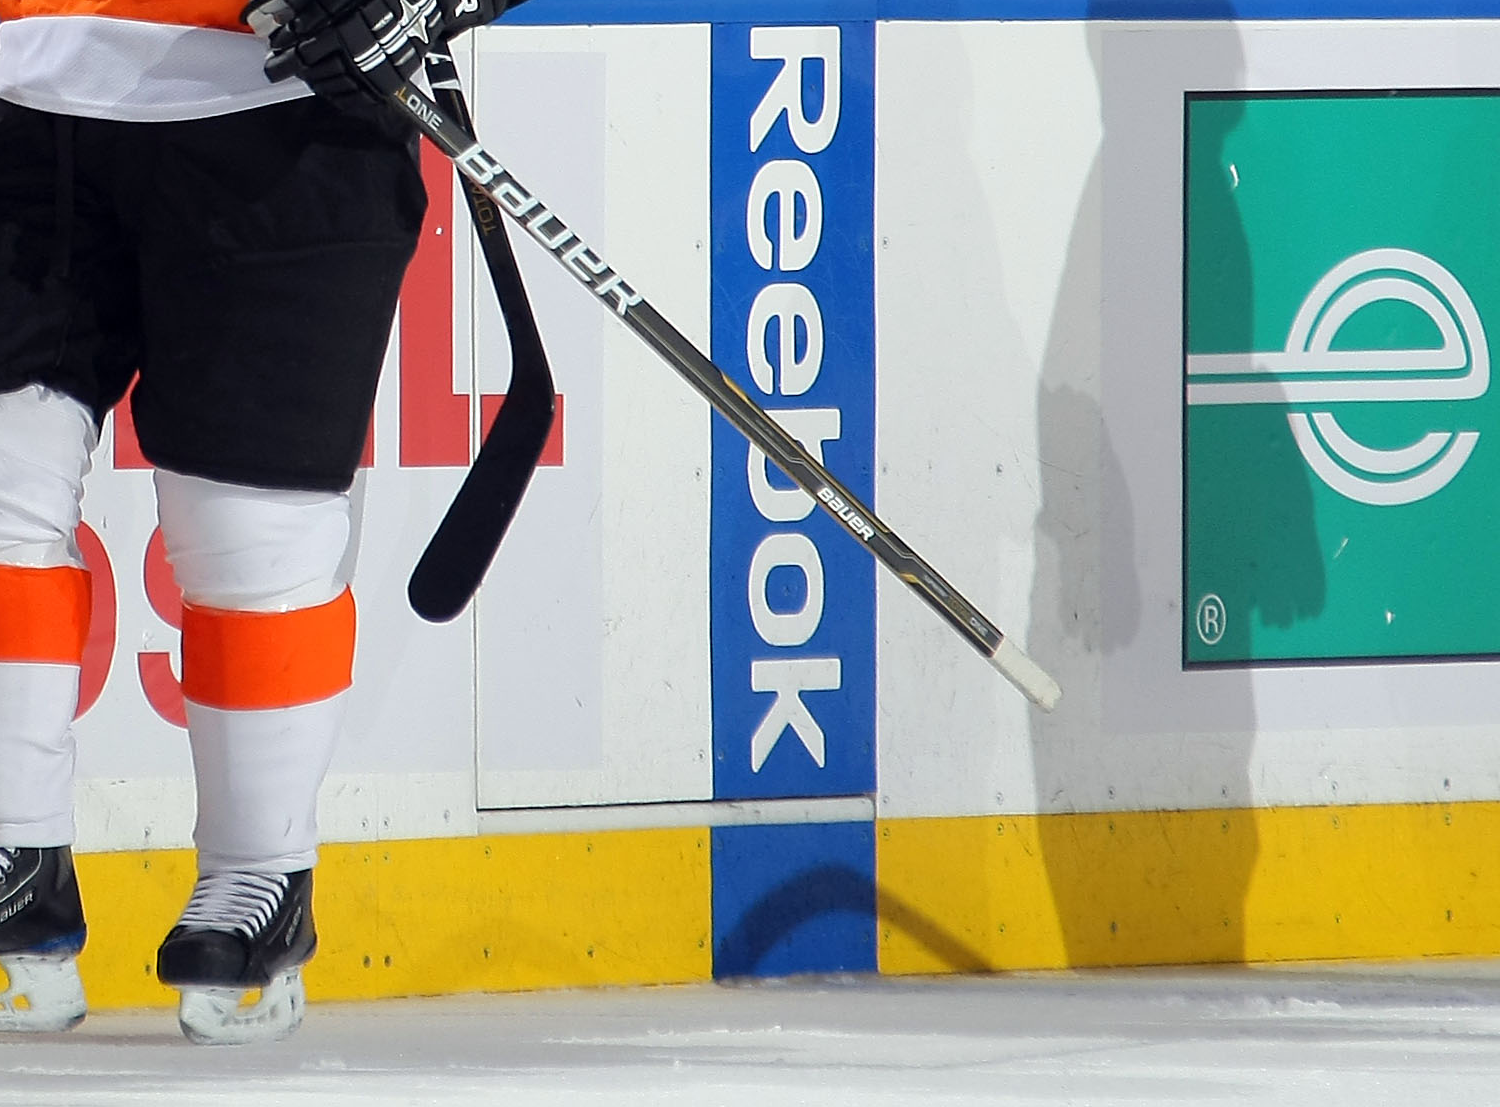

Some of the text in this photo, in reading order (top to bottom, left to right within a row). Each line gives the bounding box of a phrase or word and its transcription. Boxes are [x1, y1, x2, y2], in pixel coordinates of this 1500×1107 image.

[406, 94, 444, 131] ONE
[456, 143, 643, 317] BAUER
[746, 25, 842, 774] Reebok
[817, 486, 875, 542] BAUER
